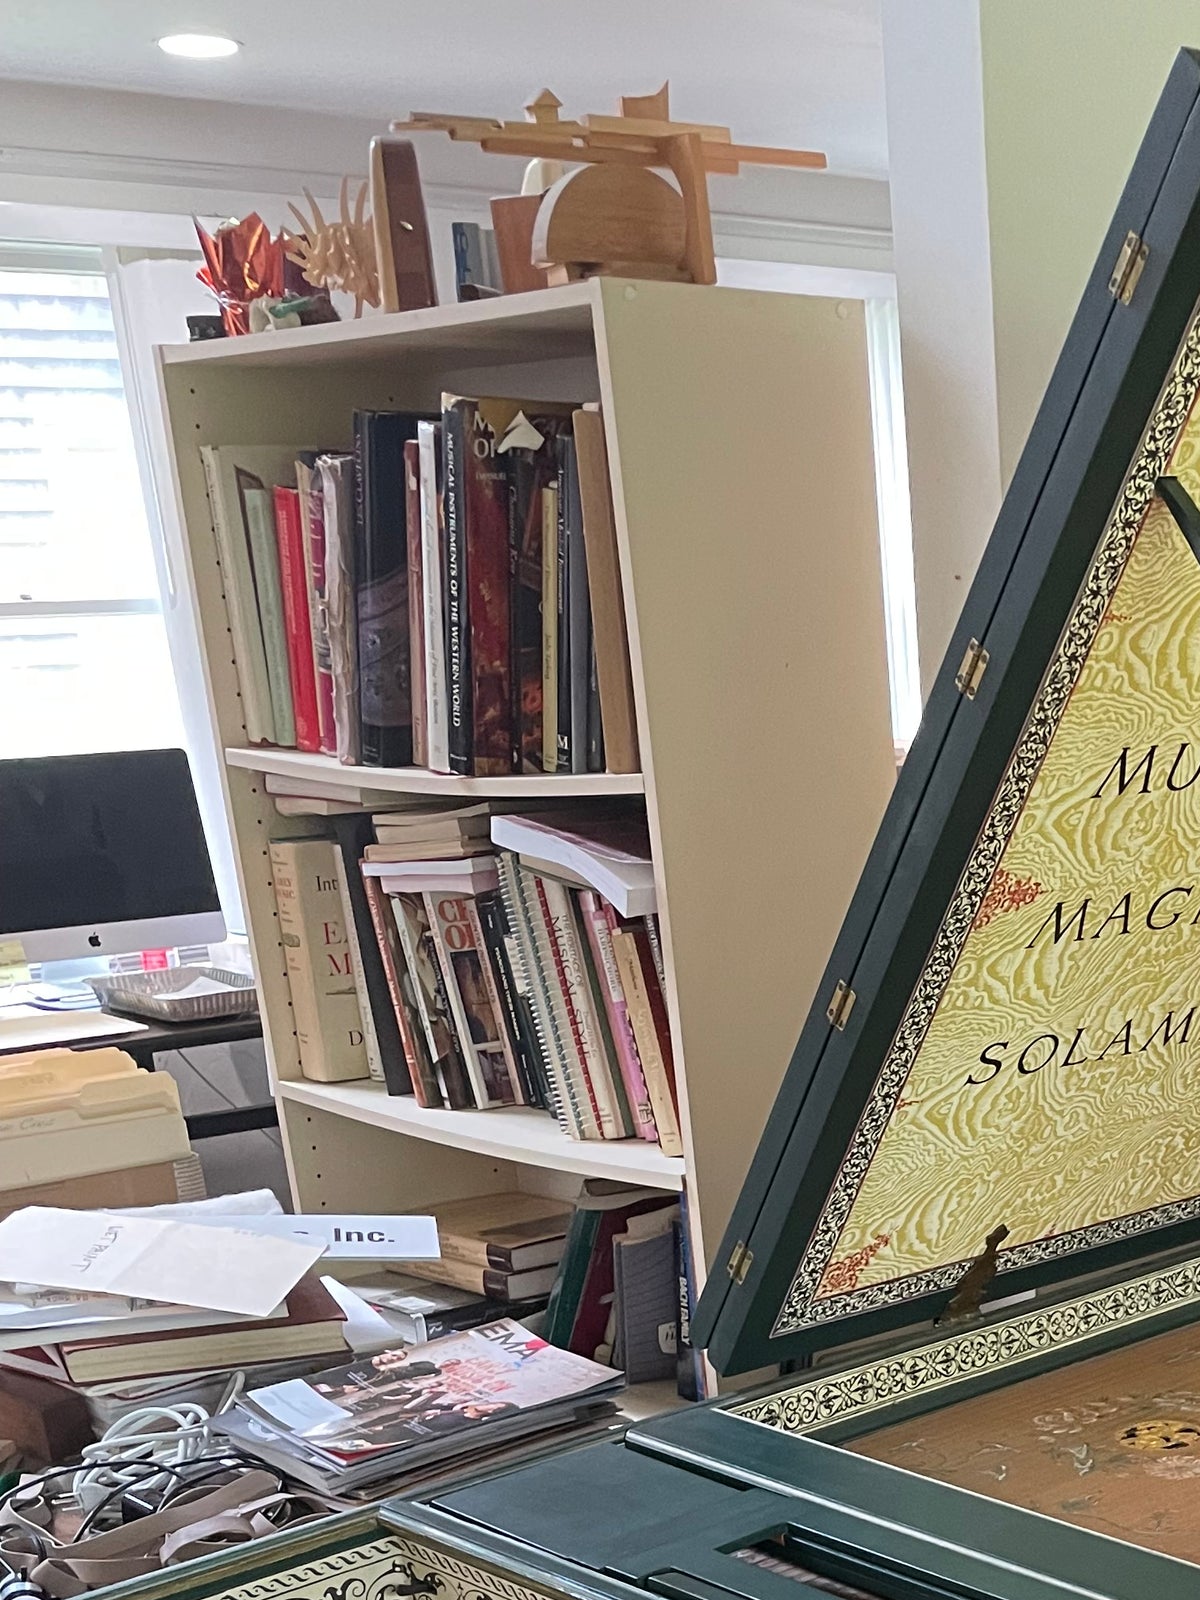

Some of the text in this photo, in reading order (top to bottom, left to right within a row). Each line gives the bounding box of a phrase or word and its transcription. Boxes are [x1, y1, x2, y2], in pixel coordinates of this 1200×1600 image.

[446, 431, 461, 727] MUSICAL INSTRUMENTS OF THE WESTERN WORLD
[550, 915, 578, 998] MUSICAL
[333, 1227, 396, 1244] Inc.
[474, 1322, 541, 1361] EMA
[678, 1275, 691, 1346] BACH FAMILY
